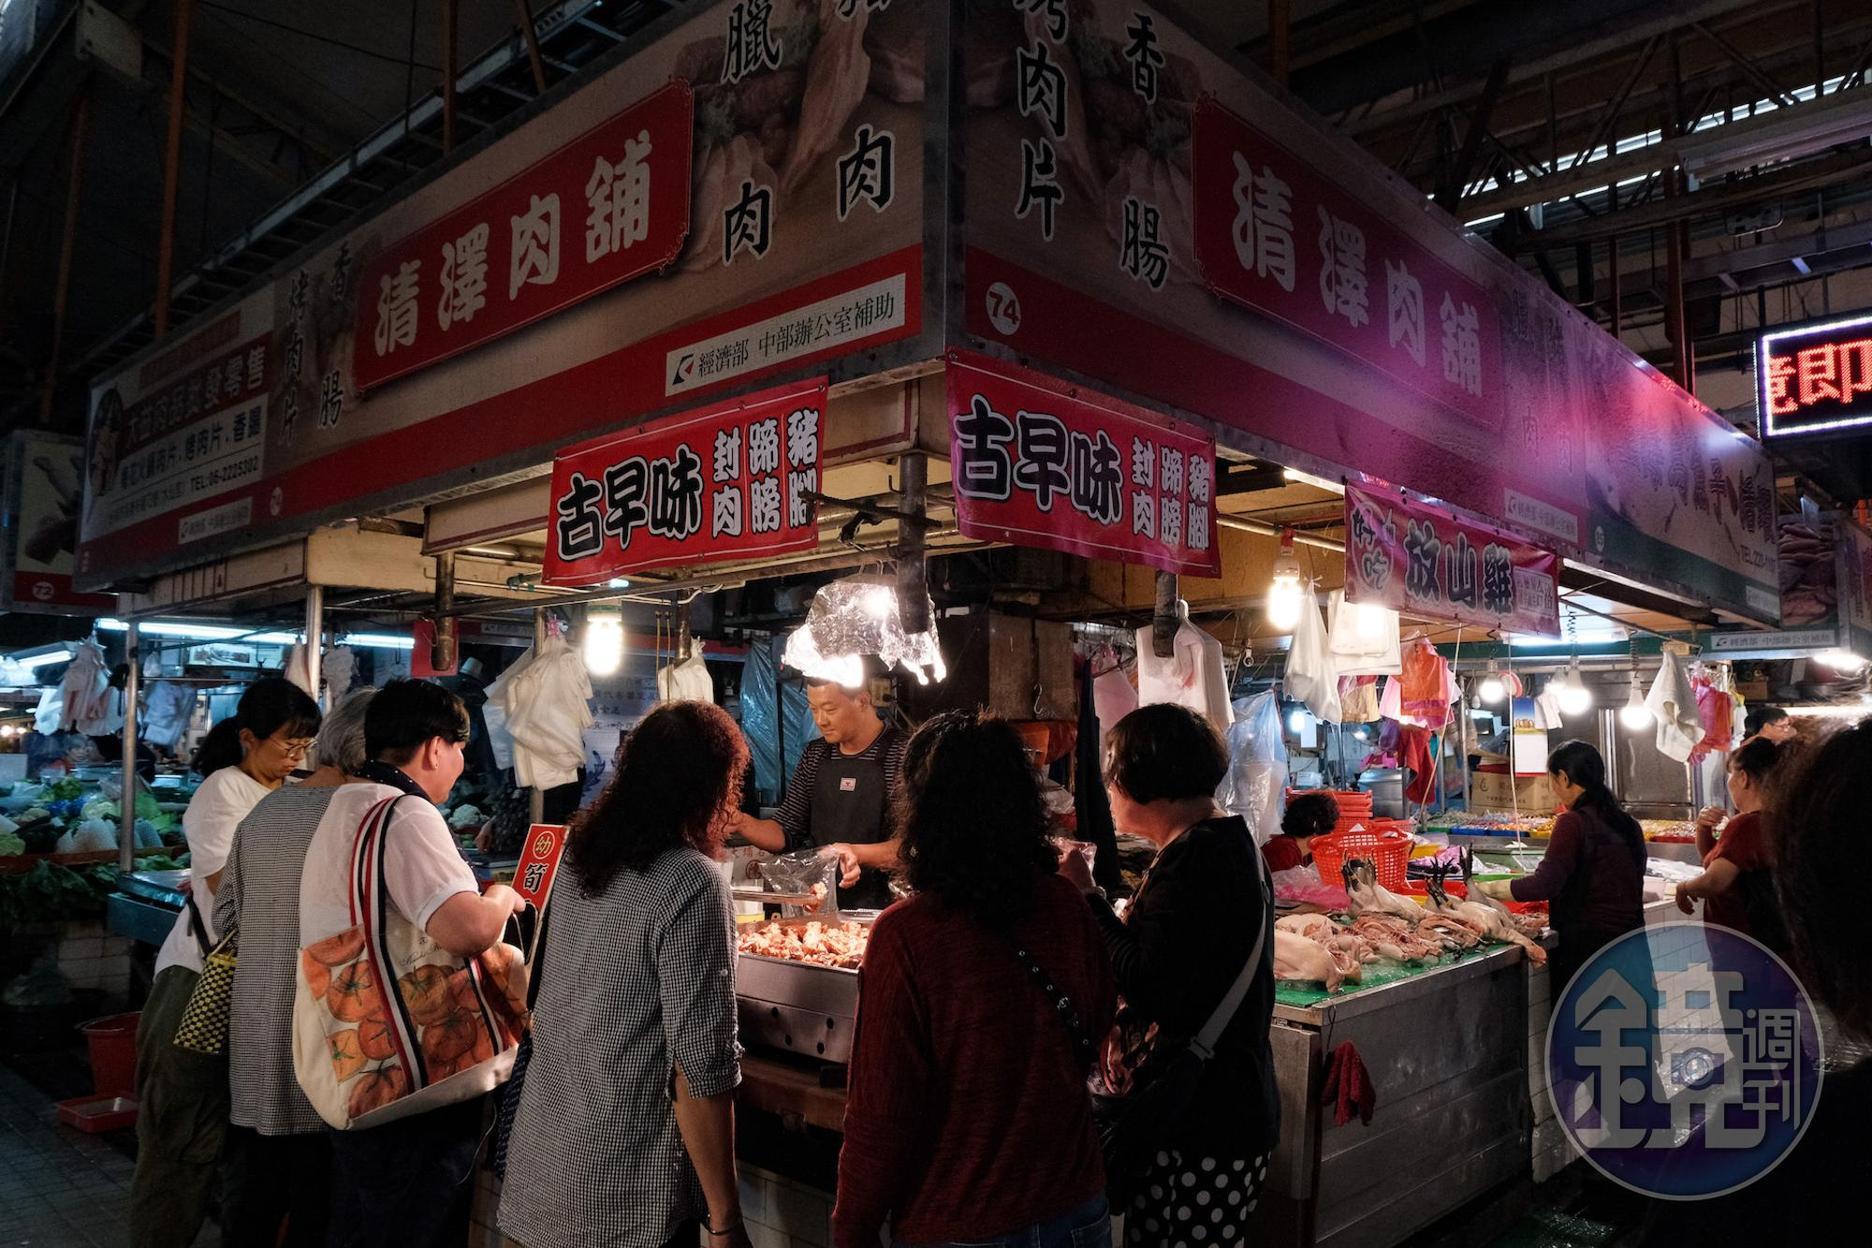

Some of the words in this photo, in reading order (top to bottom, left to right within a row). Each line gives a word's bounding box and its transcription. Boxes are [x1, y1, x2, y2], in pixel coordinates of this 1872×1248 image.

[838, 0, 893, 219] 肉
[1124, 11, 1169, 289] 香腸
[698, 338, 750, 377] 經濟部
[758, 292, 894, 357] 中部辦公室補助
[988, 291, 1019, 324] 74
[557, 443, 704, 562] 古早味
[712, 425, 743, 539] 封肉
[748, 417, 782, 534] 蹄膀
[954, 393, 1124, 525] 古早味
[1131, 436, 1156, 539] 封肉
[1160, 446, 1184, 545] 蹄膀
[1187, 454, 1211, 551] 豬腳
